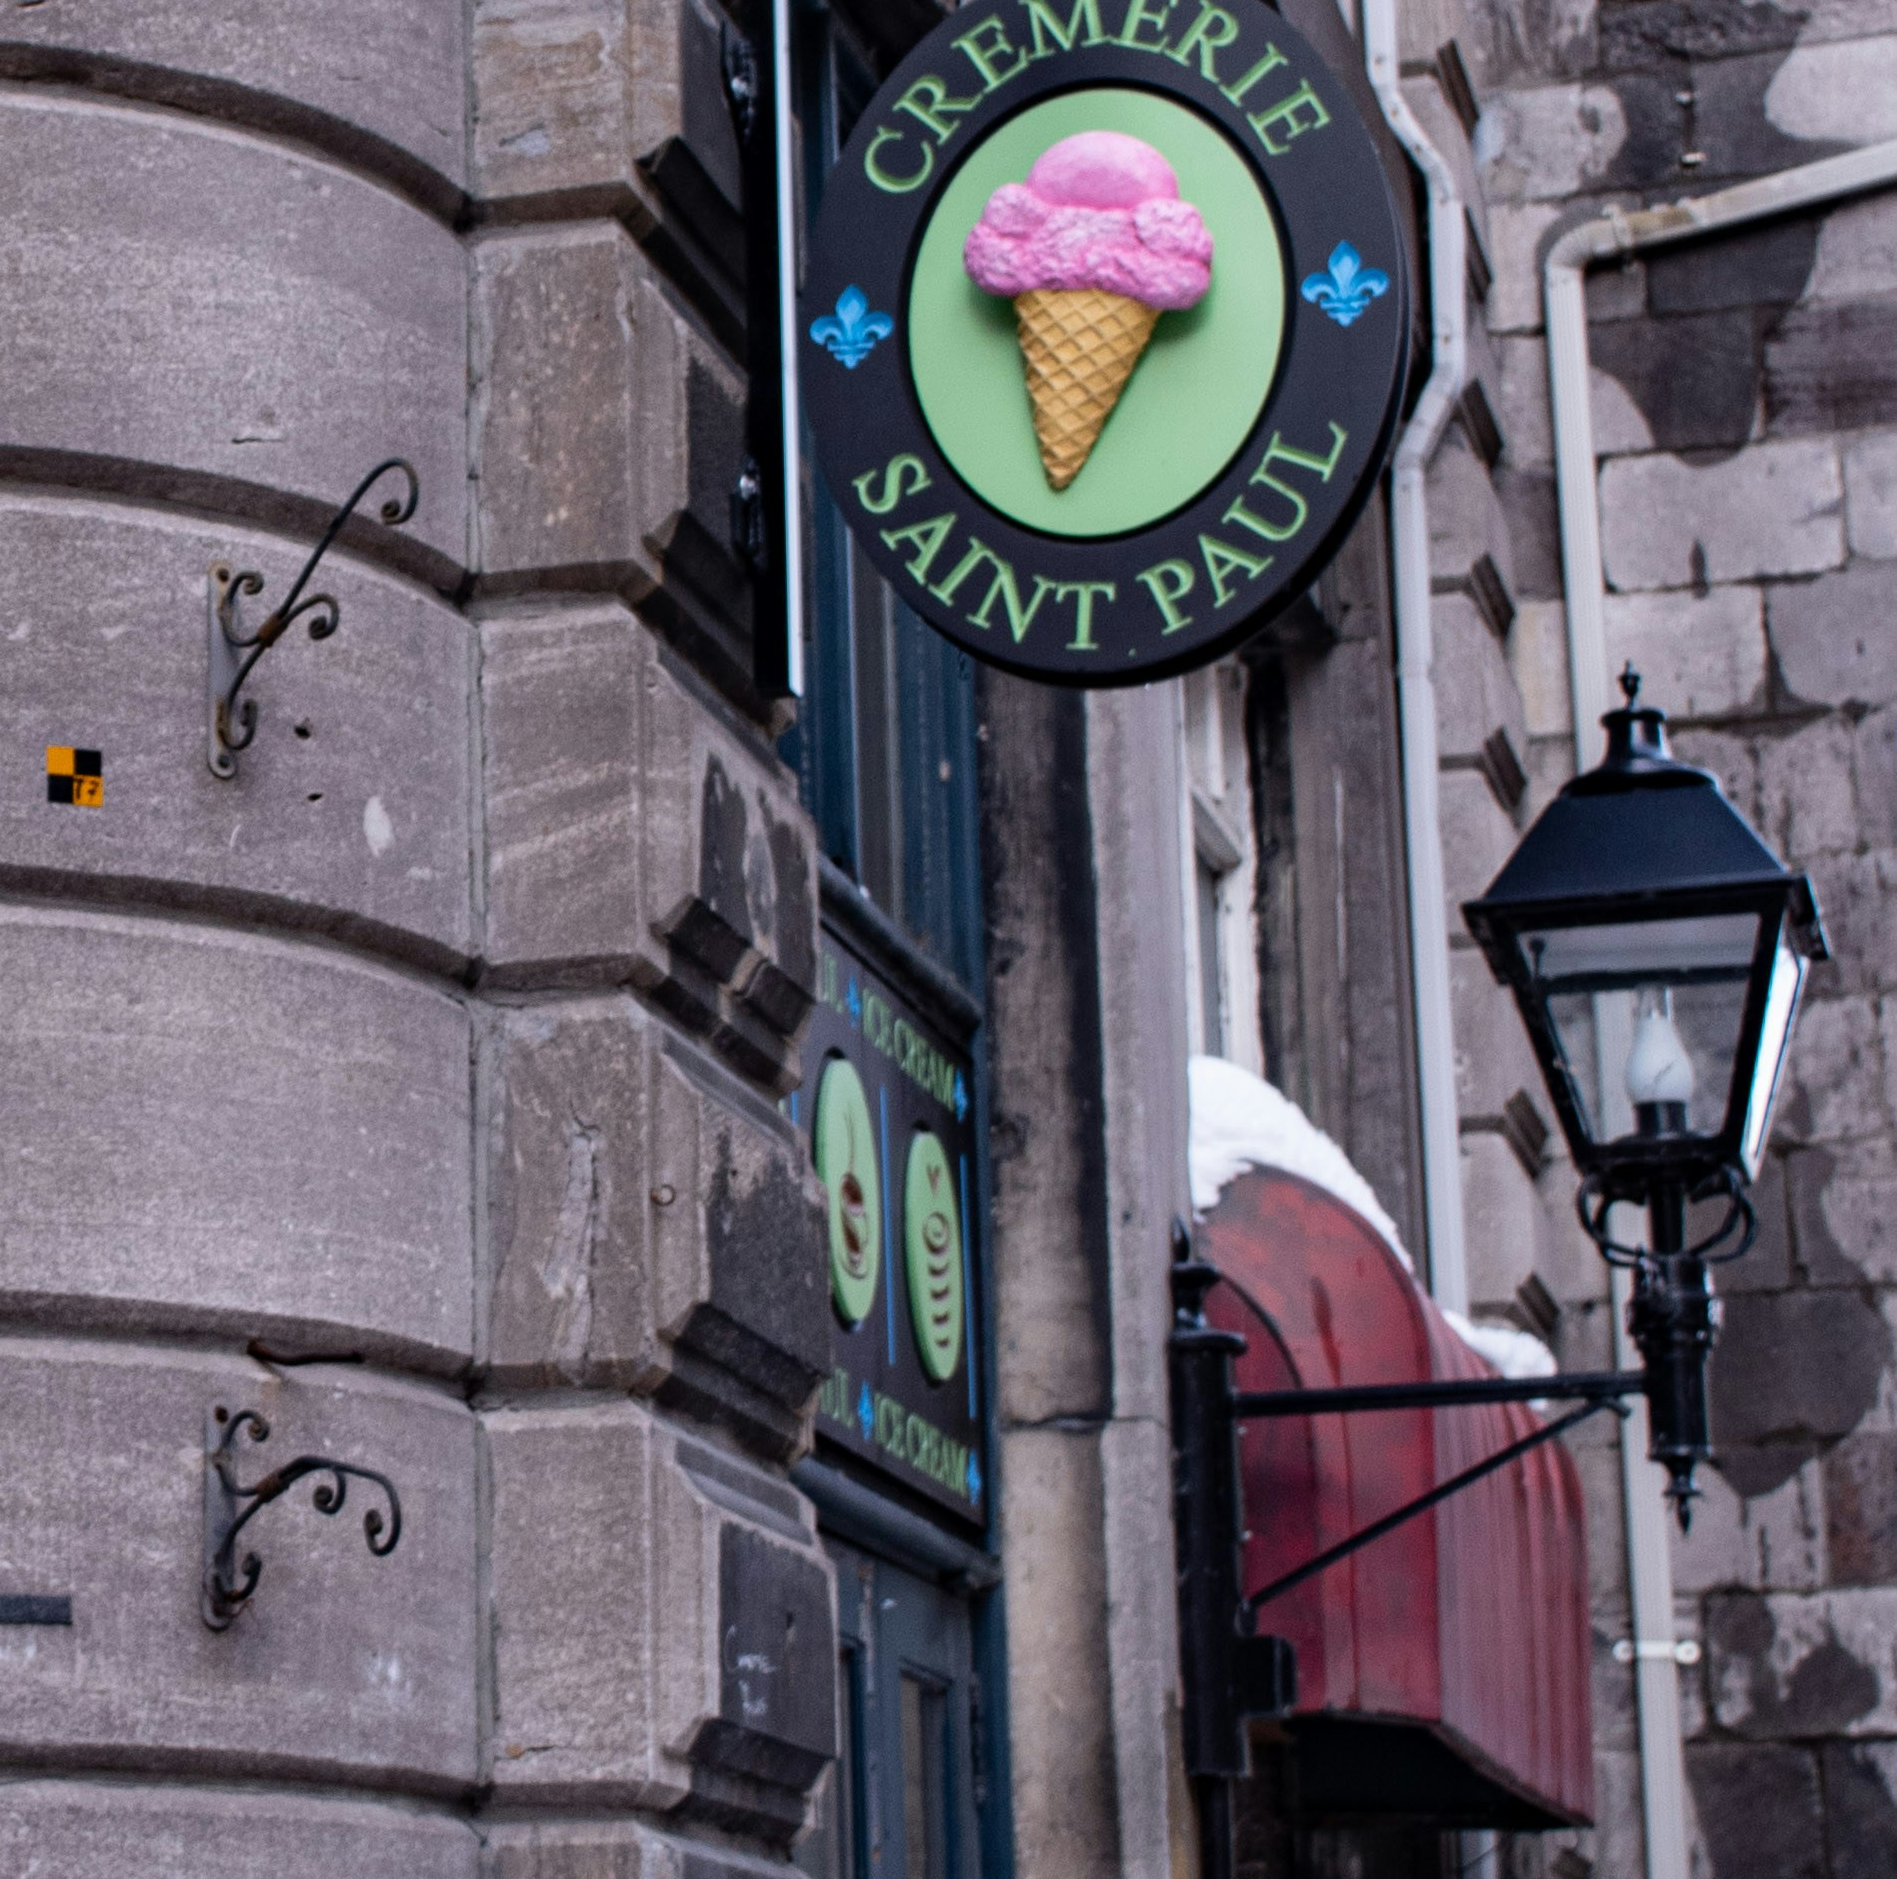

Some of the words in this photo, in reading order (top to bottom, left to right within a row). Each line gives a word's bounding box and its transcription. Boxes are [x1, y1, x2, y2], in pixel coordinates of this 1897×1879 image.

[853, 452, 1115, 651] SAINT
[1135, 420, 1349, 636] PAUL
[862, 988, 893, 1057] ICE
[894, 1018, 955, 1112] CREAM
[874, 1392, 905, 1459] ICE
[906, 1412, 968, 1499] CREAM
